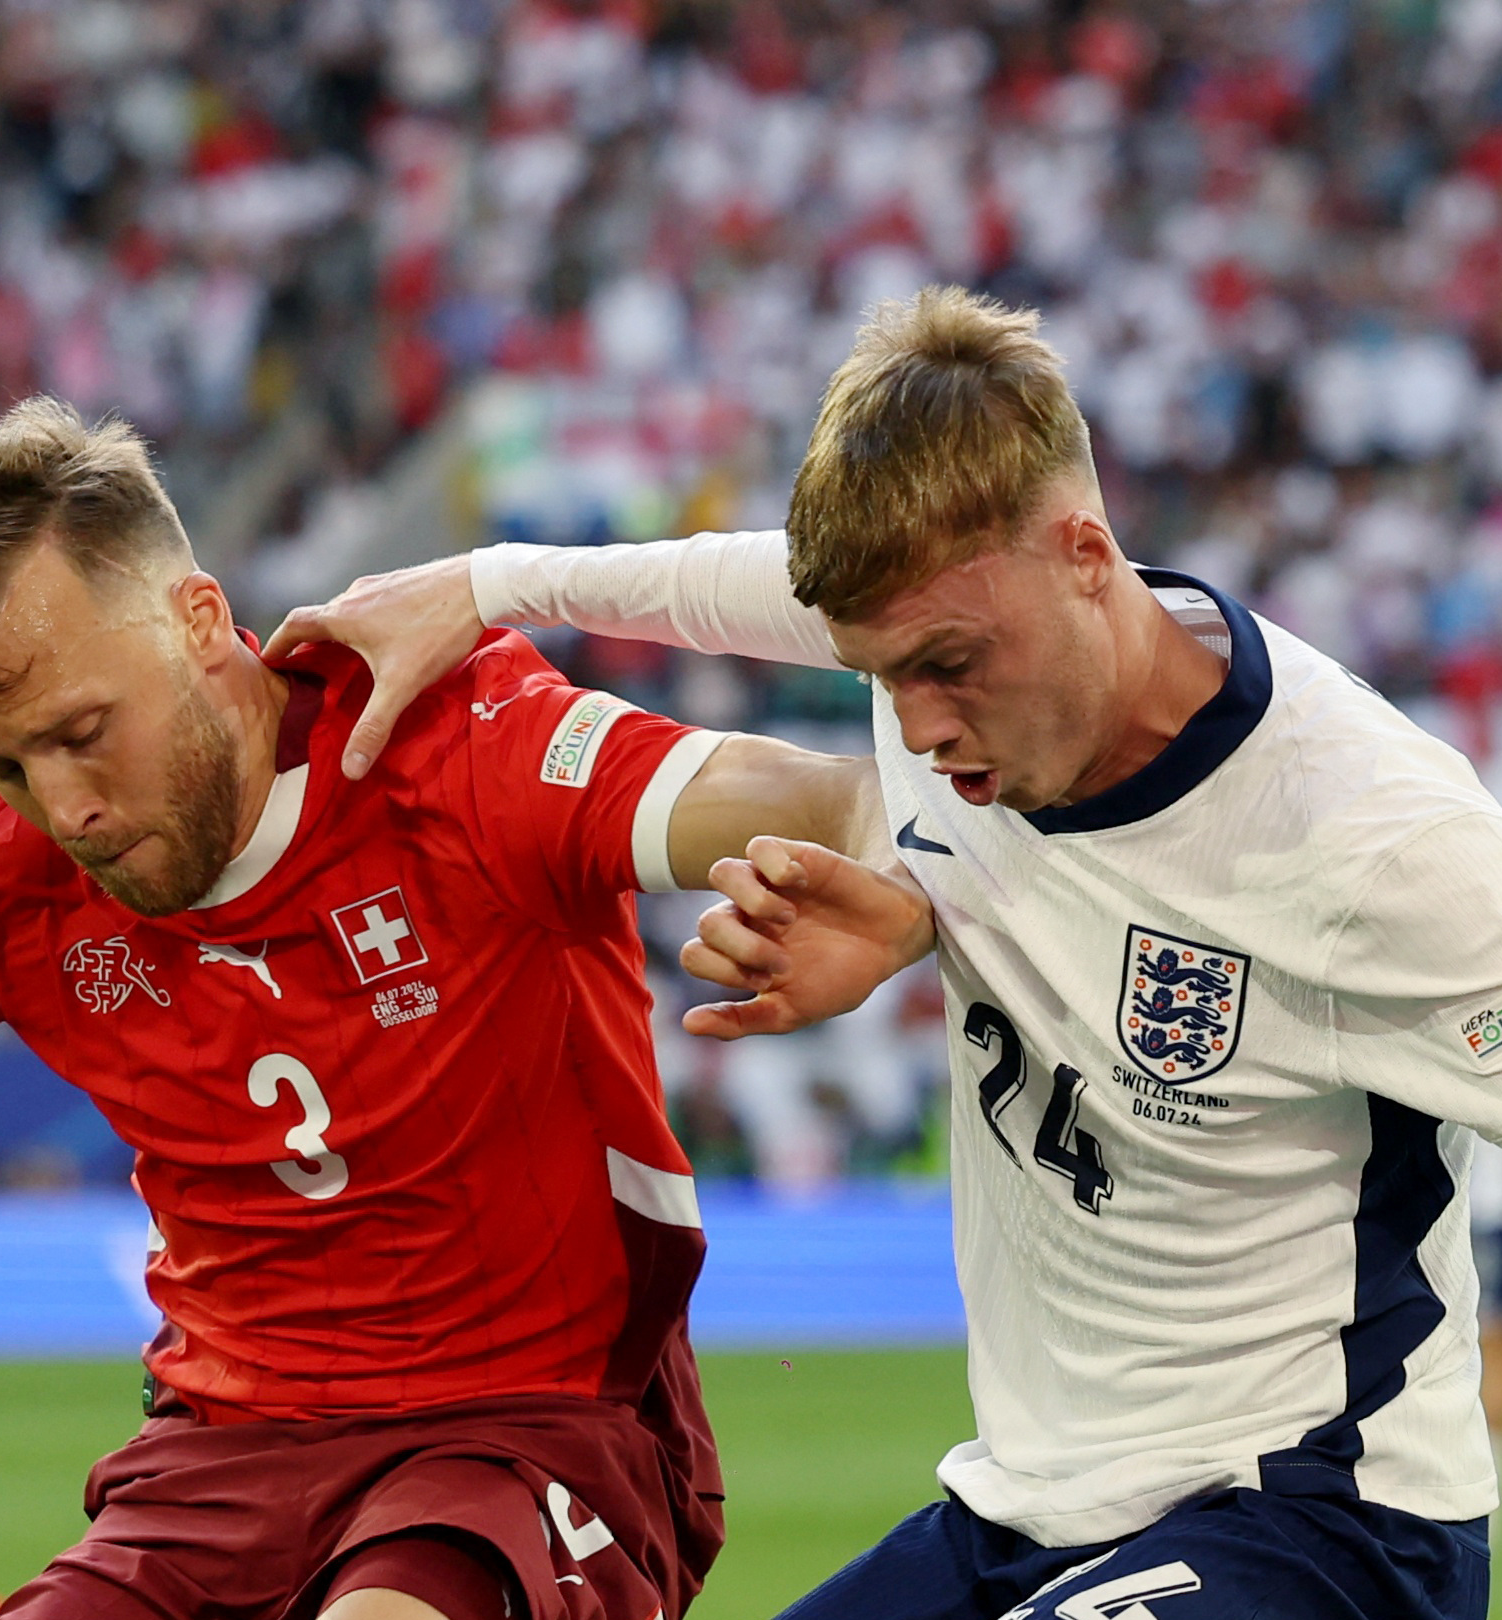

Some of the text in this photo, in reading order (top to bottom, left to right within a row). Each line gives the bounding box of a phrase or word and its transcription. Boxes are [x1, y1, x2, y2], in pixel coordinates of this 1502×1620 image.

[544, 743, 562, 779] UEFA
[371, 1000, 400, 1021] ENG
[413, 985, 440, 1006] SUI
[375, 980, 425, 1004] 06.07.2024
[1461, 1008, 1496, 1036] UEFA
[1112, 1065, 1230, 1108] SWITZERLAND
[248, 1053, 349, 1200] 3
[963, 1001, 1114, 1217] 24
[1132, 1098, 1202, 1126] 06.07.24
